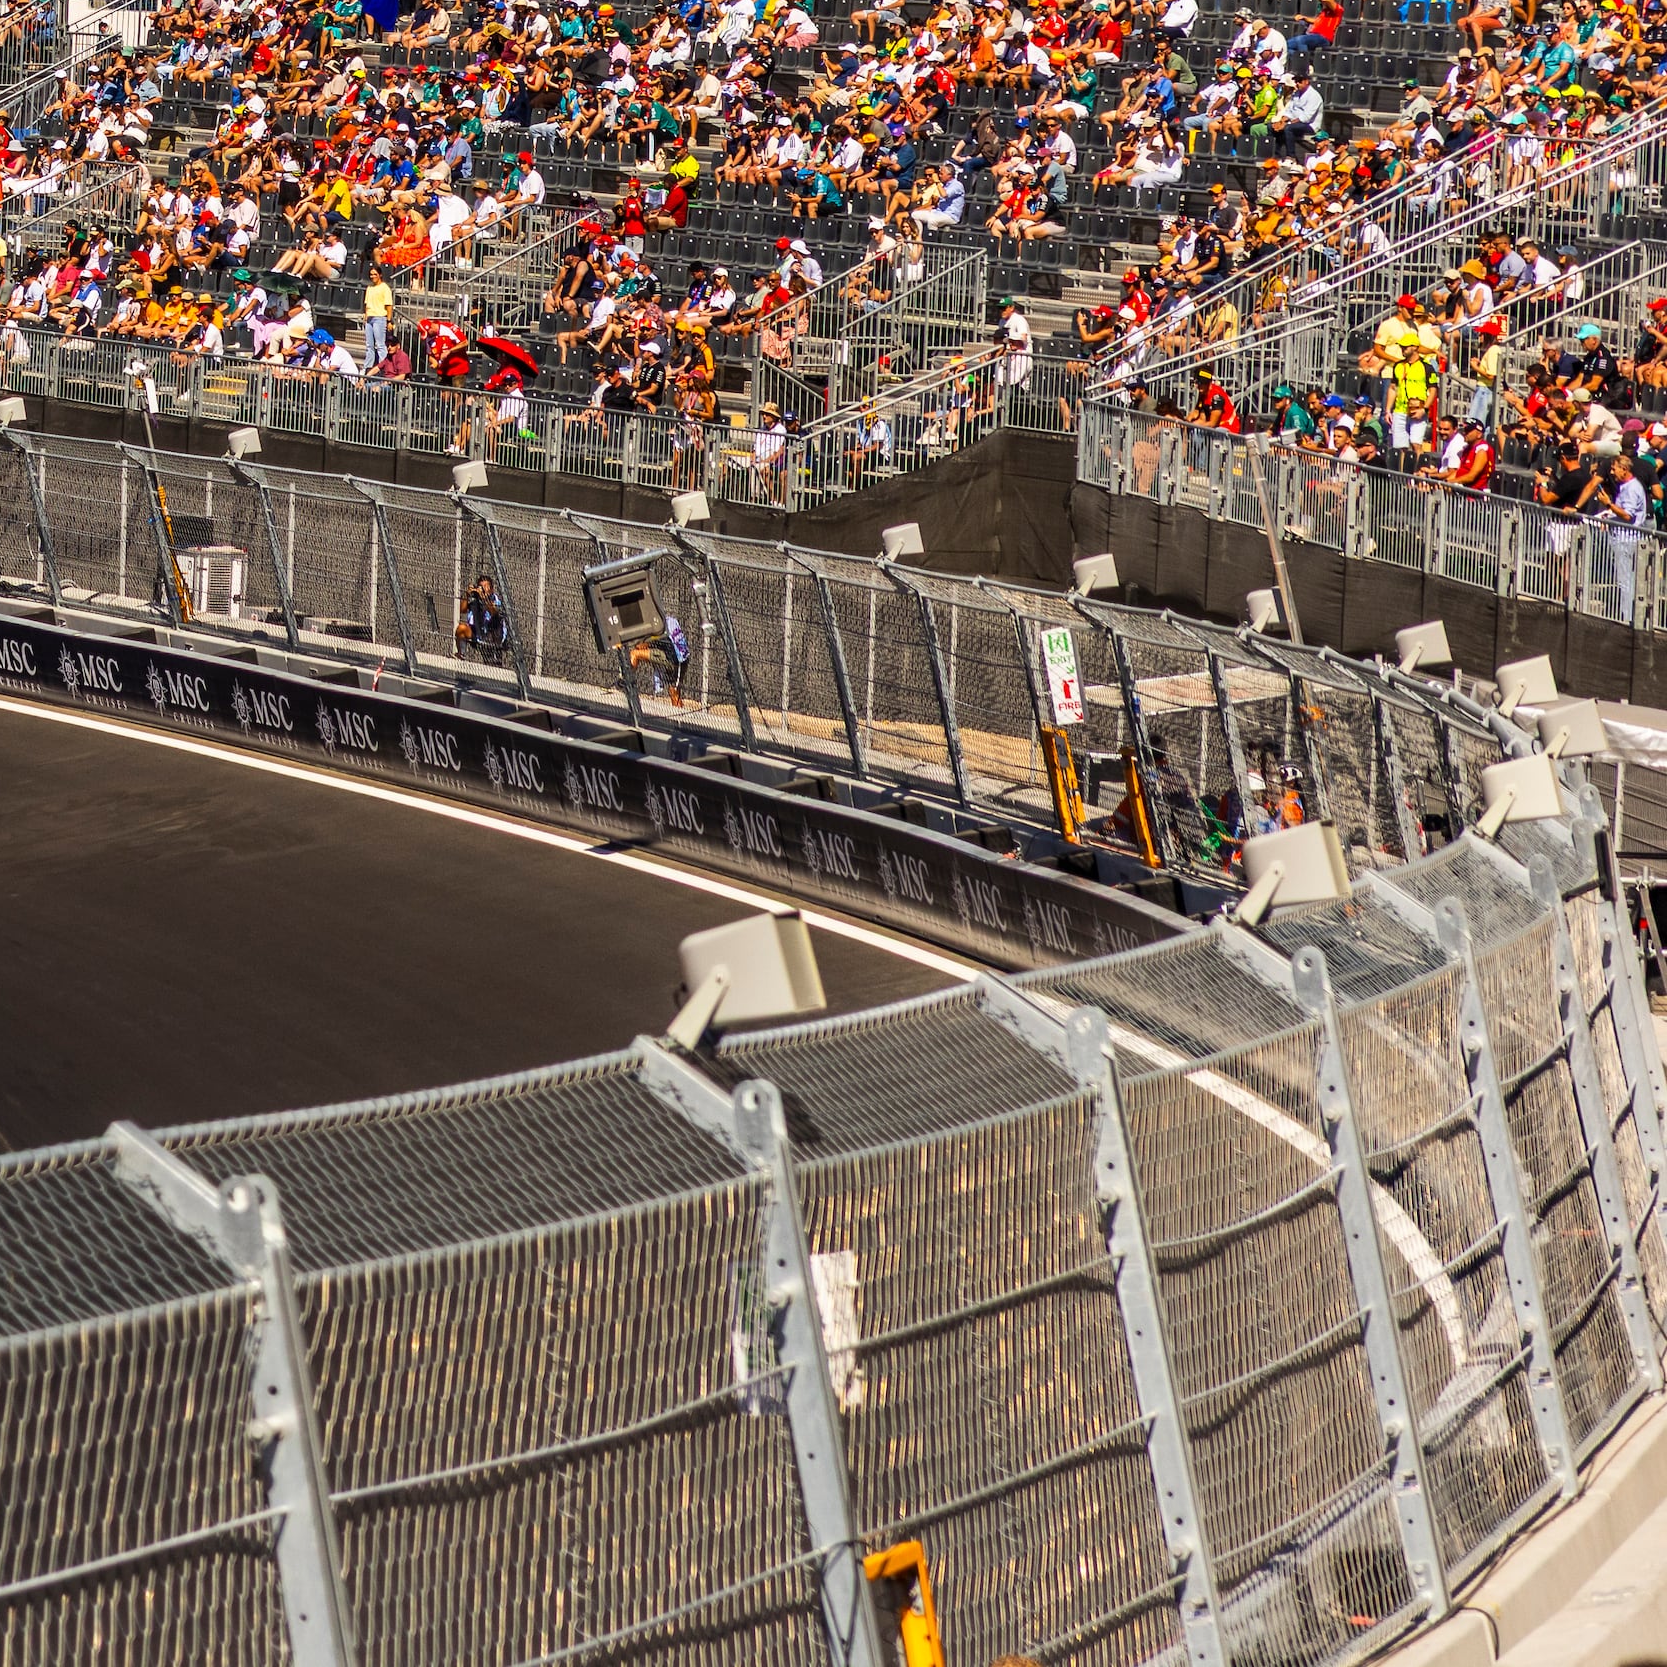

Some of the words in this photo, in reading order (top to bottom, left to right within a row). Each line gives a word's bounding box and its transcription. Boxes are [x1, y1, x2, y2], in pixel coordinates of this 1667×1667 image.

[0, 676, 41, 695] CRUISES
[78, 653, 122, 692] MSC
[165, 670, 209, 711] MSC
[86, 693, 127, 711] CRUISES
[173, 711, 214, 731] CRUISES
[250, 689, 293, 731] MSC
[1058, 702, 1081, 711] FIRE
[258, 732, 298, 750] CRUISES
[334, 709, 378, 751] MSC
[417, 727, 460, 771] MSC
[501, 747, 544, 792] MSC
[580, 765, 623, 811] MSC
[661, 787, 703, 834] MSC
[740, 808, 781, 857] MSC
[818, 830, 859, 881] MSC
[893, 852, 933, 905] MSC
[966, 877, 1007, 932] MSC
[1036, 902, 1076, 955] MSC
